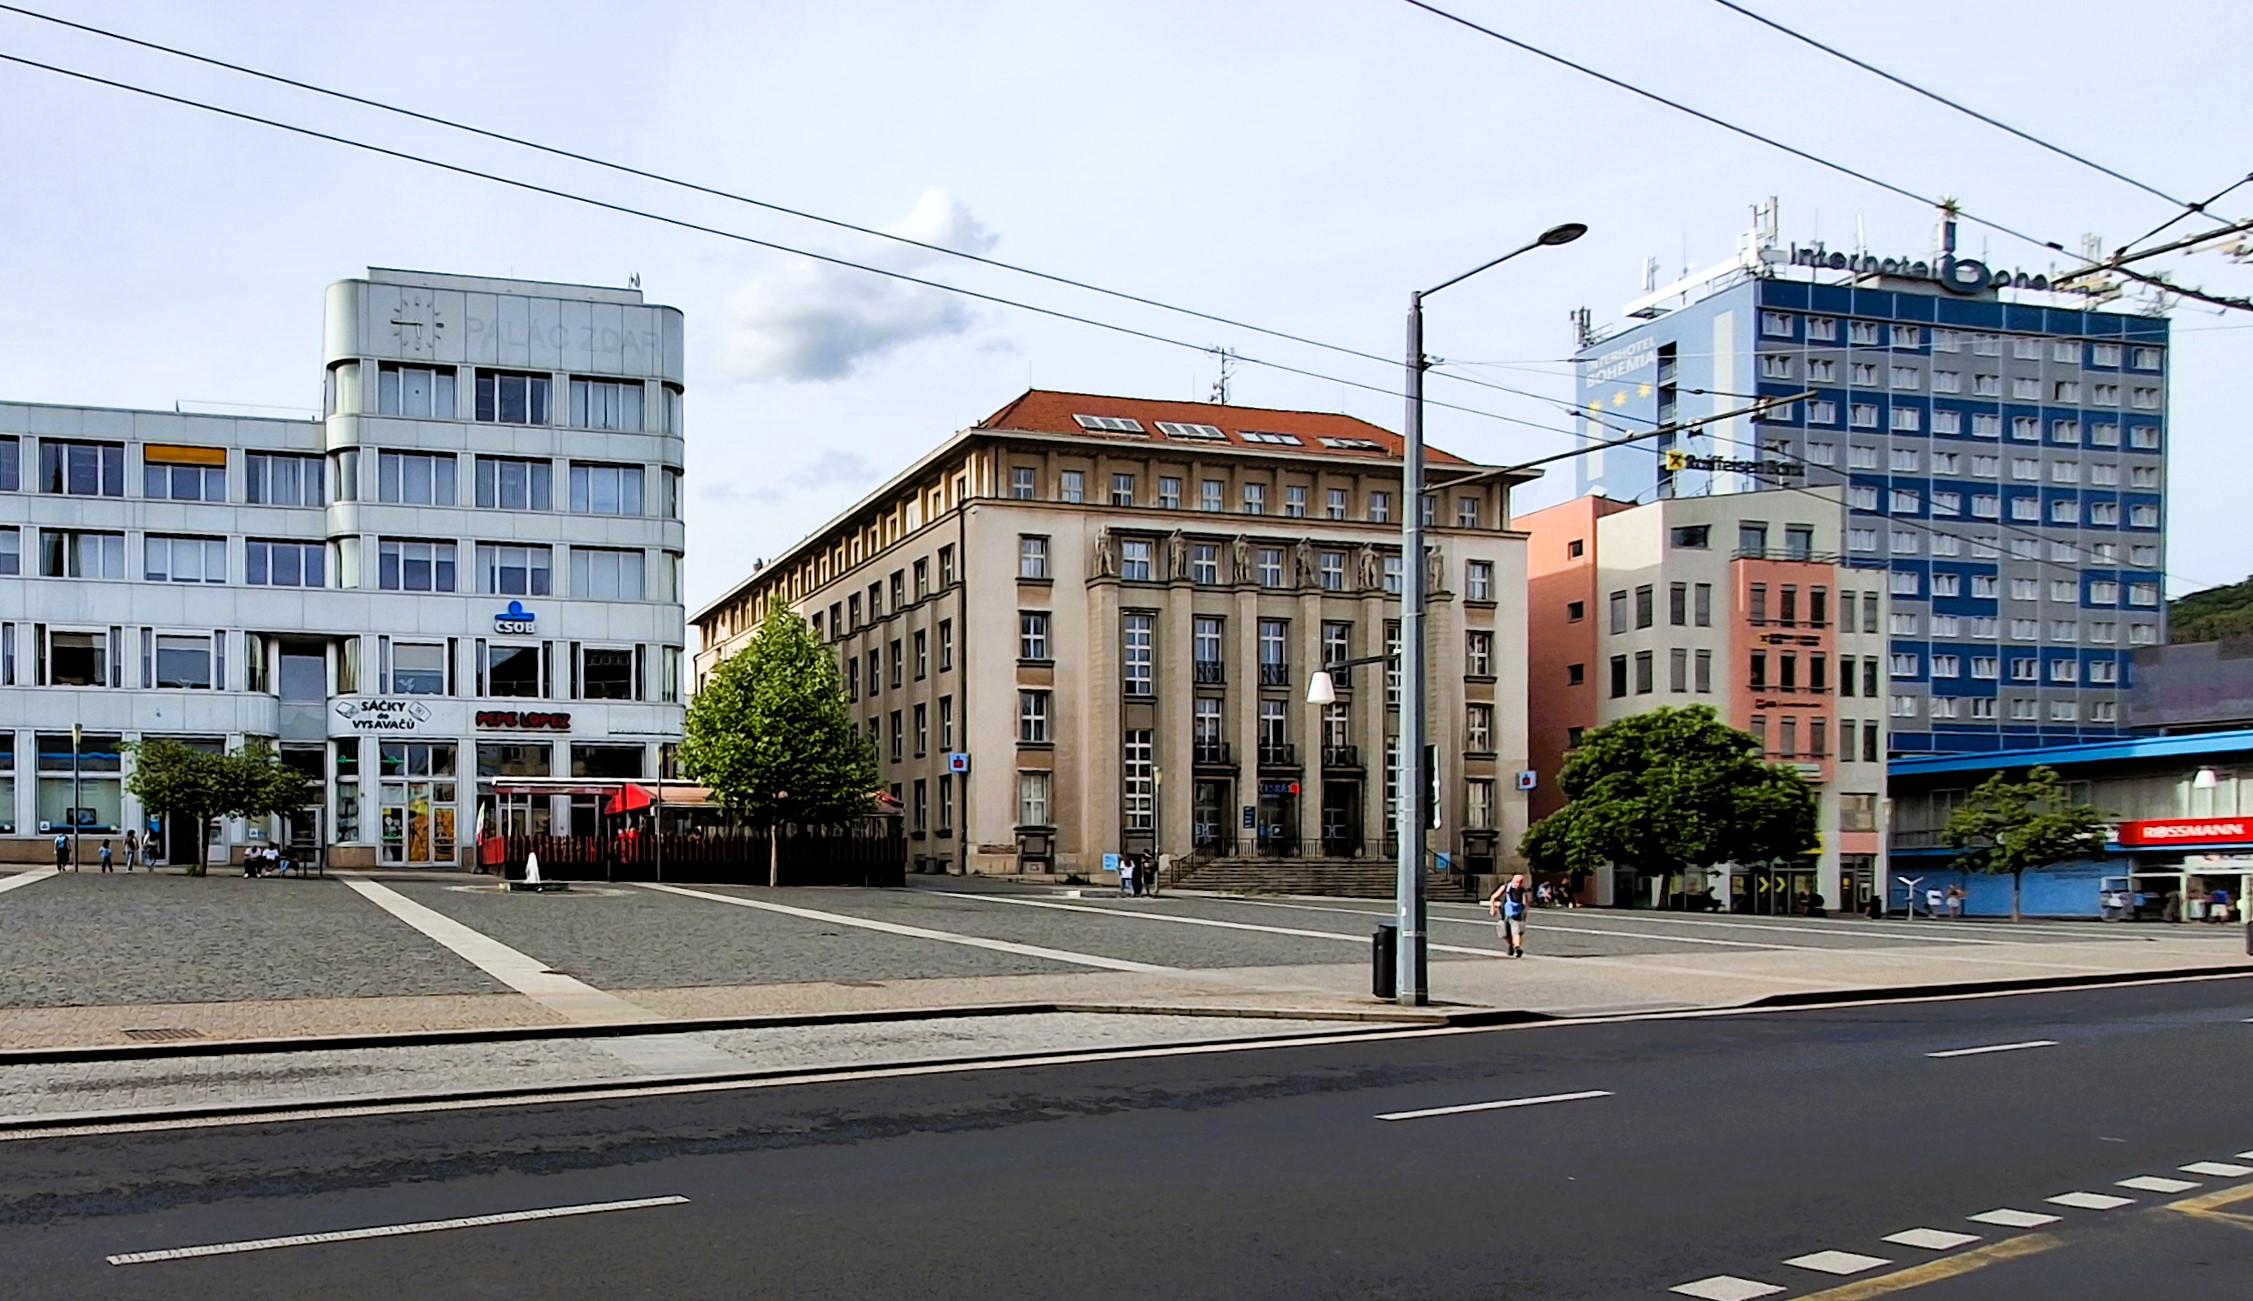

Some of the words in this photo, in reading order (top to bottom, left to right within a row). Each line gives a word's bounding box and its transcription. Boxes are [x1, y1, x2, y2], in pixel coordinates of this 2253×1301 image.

[1790, 241, 1937, 278] Interhotel
[1586, 350, 1656, 388] BOHEMIA
[361, 700, 406, 712] SÁČKY
[352, 719, 415, 730] VYSAVAČŮ
[476, 711, 518, 728] PEPE
[520, 712, 571, 729] LOPEZ
[2143, 824, 2246, 839] ROSSMANN
